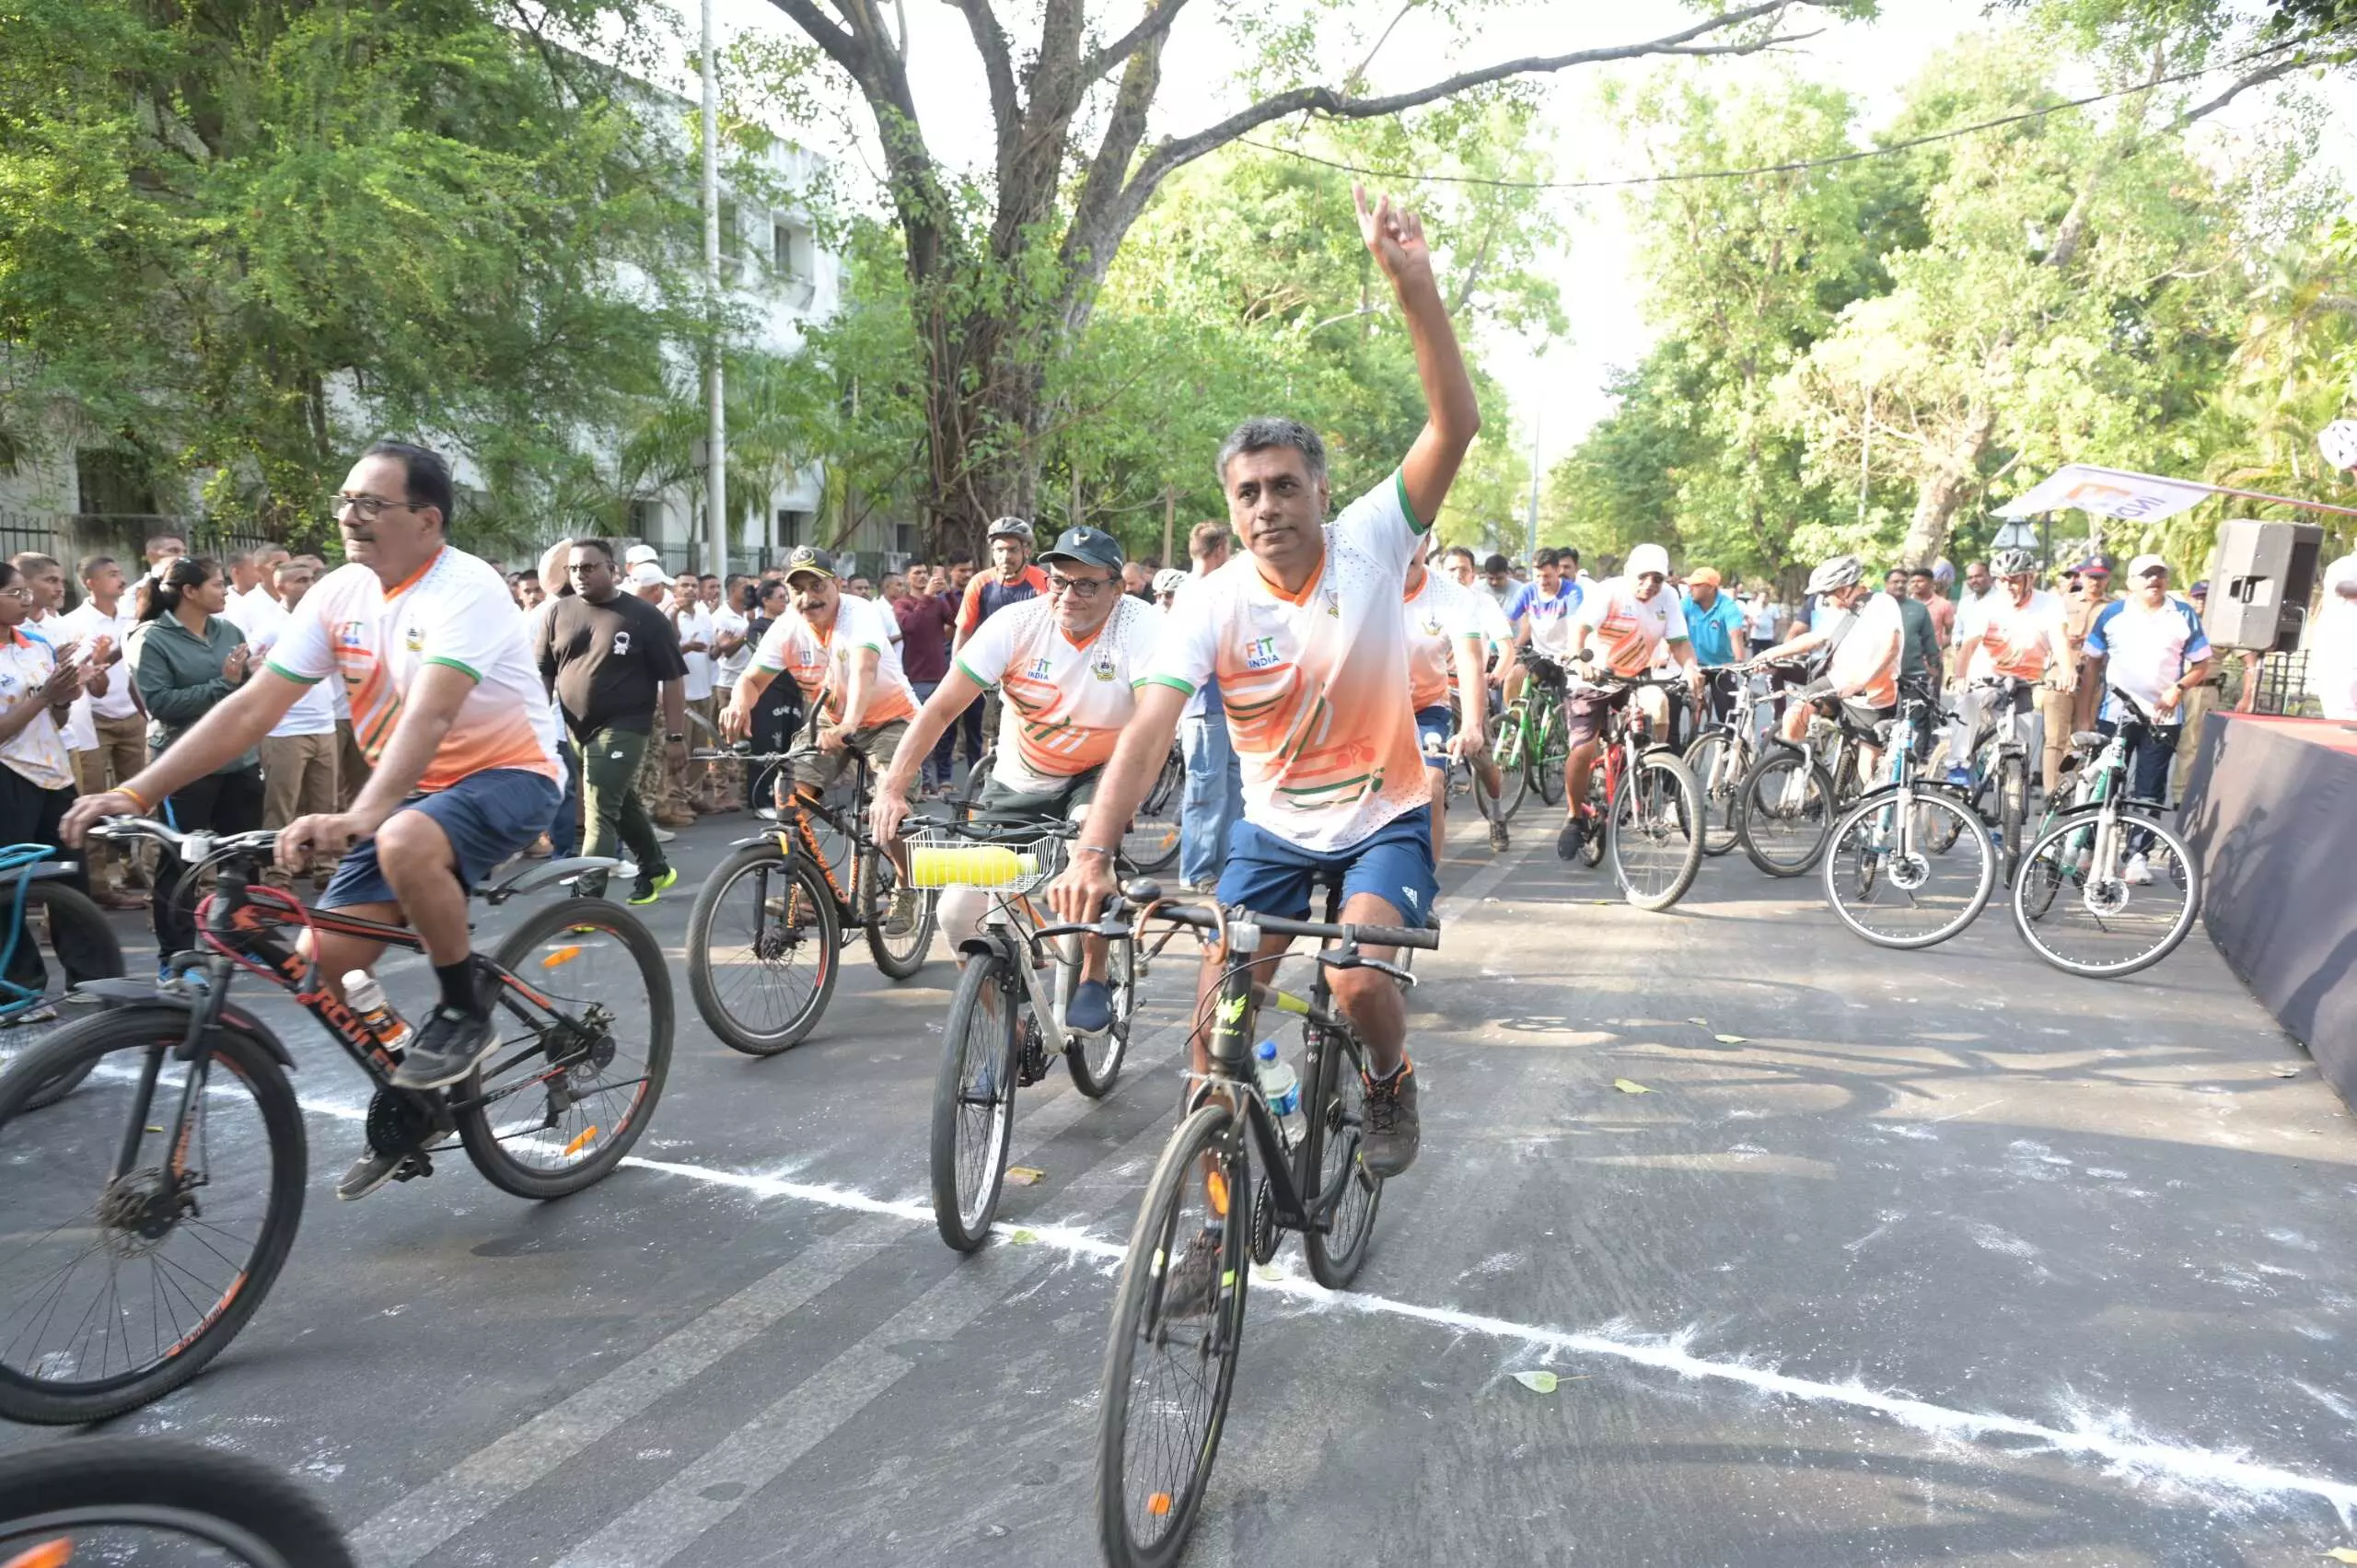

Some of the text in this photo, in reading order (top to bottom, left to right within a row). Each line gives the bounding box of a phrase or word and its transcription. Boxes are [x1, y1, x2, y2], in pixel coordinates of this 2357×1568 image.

[1246, 636, 1274, 658] FIT
[1030, 657, 1052, 672] FIT
[1248, 655, 1280, 668] INDIA
[1027, 670, 1050, 680] INDIA
[281, 952, 399, 1081] HRCULES
